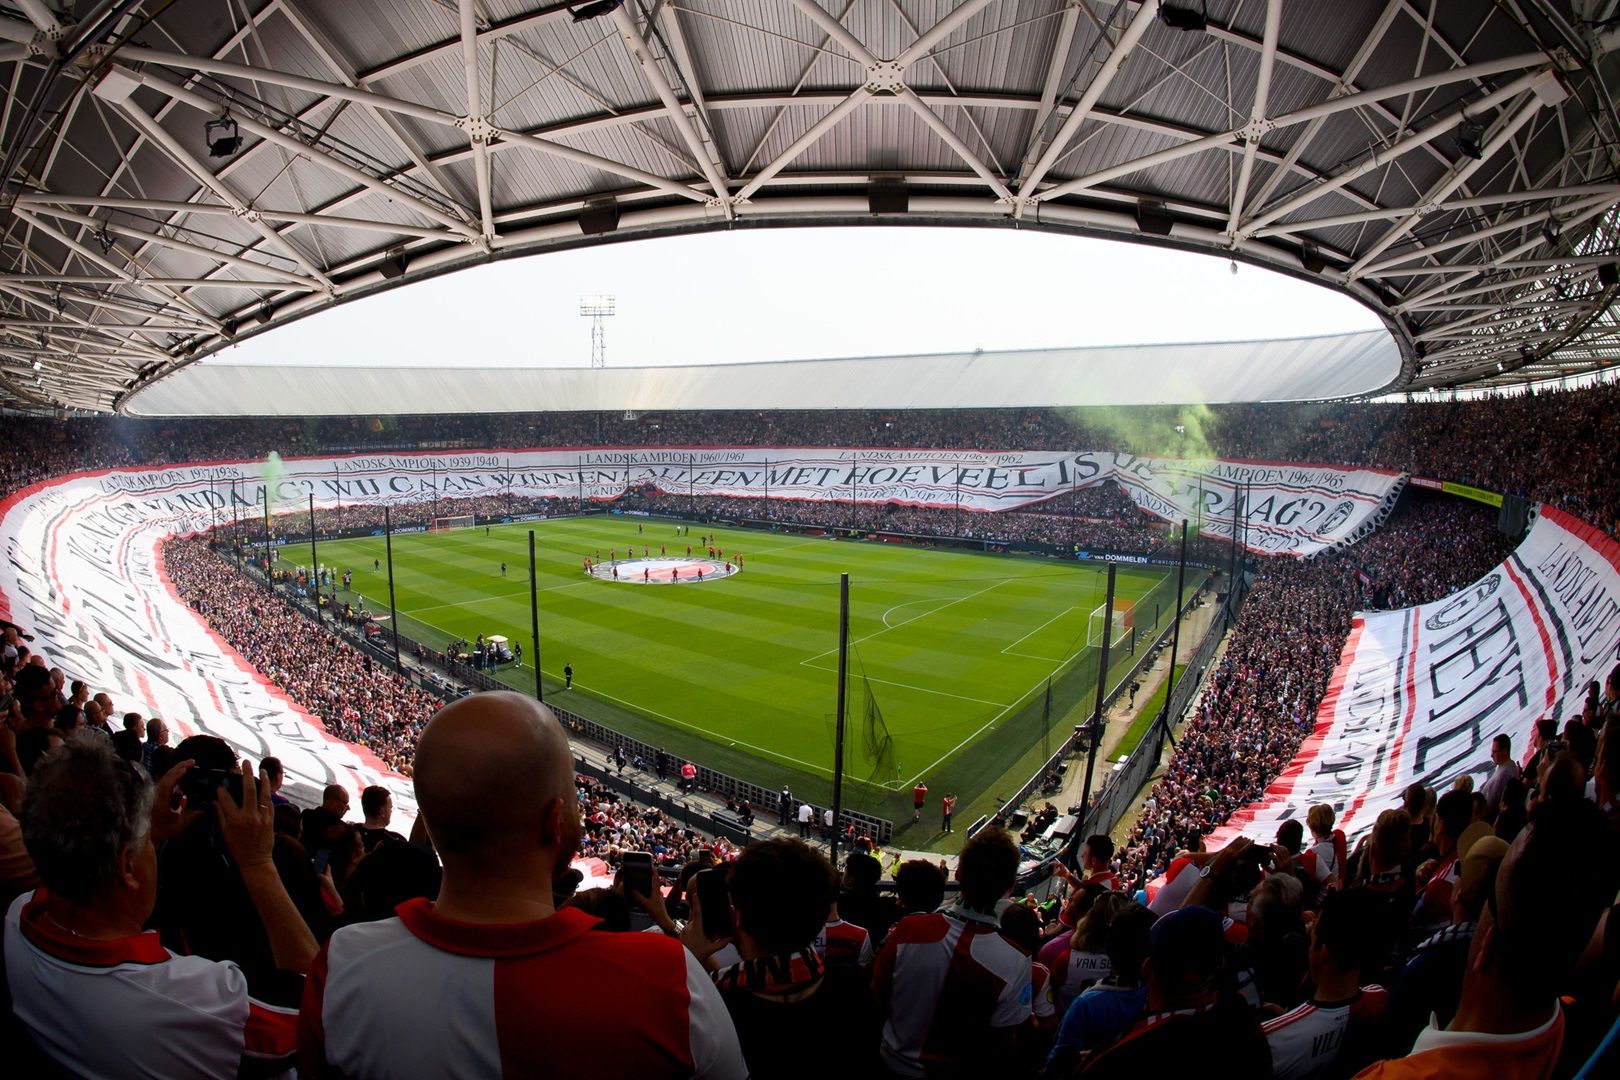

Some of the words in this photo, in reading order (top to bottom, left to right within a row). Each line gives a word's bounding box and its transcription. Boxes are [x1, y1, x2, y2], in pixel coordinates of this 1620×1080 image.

[586, 452, 697, 464] LANDSKAMPIOEN
[700, 452, 745, 462] 1960/1961
[838, 451, 962, 461] LANDSKAMPIOEN
[333, 457, 447, 472] LANDSKAMPIOEN
[449, 456, 499, 468] 1939/1940
[100, 469, 186, 493] LANDSKAMPIOEN
[190, 466, 240, 480] 1937/1938
[321, 478, 381, 497] WIJ
[389, 475, 486, 493] GAAN
[638, 467, 763, 487] ALLEEN
[761, 464, 839, 487] MET
[841, 465, 1045, 491] HOEVEEL
[1057, 452, 1101, 486] IS
[394, 526, 426, 535] DOMMELEN
[1105, 554, 1148, 565] DOMMELEN
[1076, 957, 1097, 970] VAN
